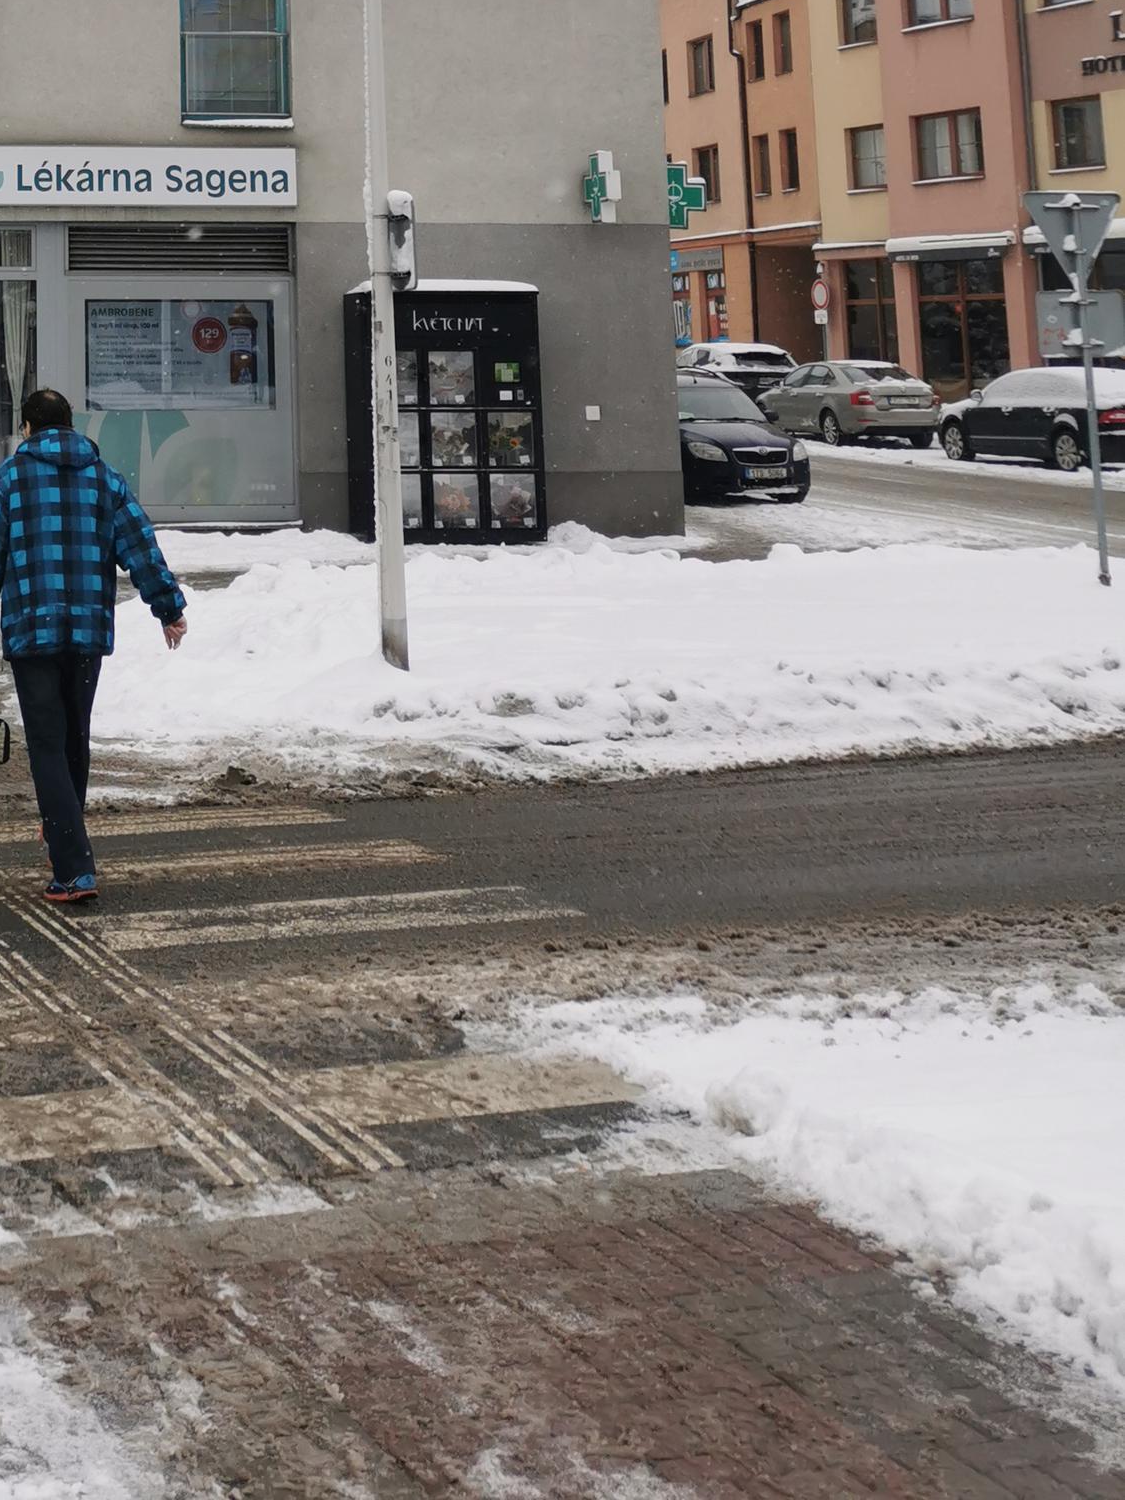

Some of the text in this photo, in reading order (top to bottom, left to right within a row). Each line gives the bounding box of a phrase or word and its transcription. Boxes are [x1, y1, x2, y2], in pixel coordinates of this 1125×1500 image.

[16, 160, 289, 198] Lékárna Sagena
[90, 307, 154, 317] AMBROBENE
[200, 328, 220, 339] 129
